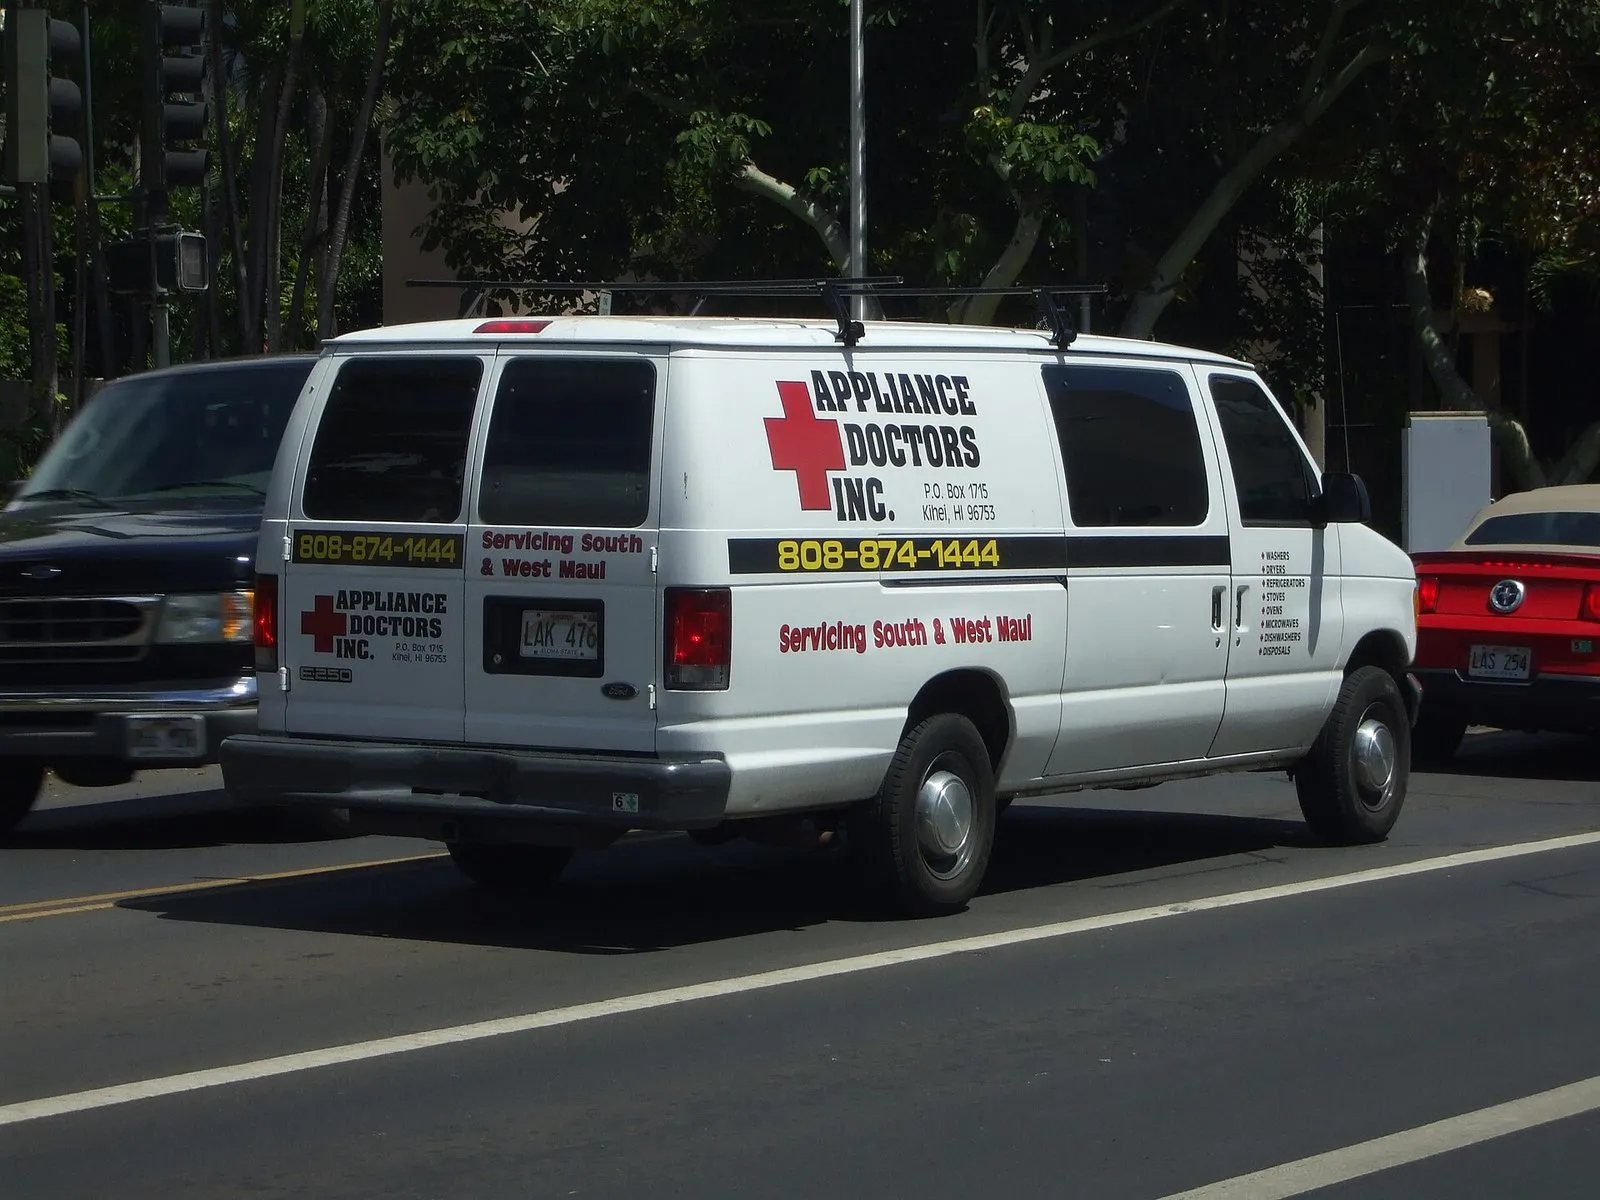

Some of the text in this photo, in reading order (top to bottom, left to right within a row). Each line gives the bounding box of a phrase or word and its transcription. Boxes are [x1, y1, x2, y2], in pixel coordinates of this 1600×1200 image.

[810, 370, 978, 416] APPLIANCE
[843, 423, 981, 468] DOCTORS
[832, 477, 896, 522] INC.
[923, 483, 989, 499] P.O. Box 1715
[922, 504, 996, 524] Kihei, HI 96753
[299, 534, 456, 564] 808-874-1444
[482, 530, 643, 554] Servicing South
[777, 539, 1000, 570] 808-874-1444
[1266, 551, 1290, 560] WASHERS
[480, 557, 494, 576] &
[502, 558, 551, 577] West
[1266, 565, 1286, 574] DRYERS
[1266, 578, 1306, 588] REFRIGERATORS
[336, 590, 447, 614] APPLIANCE
[1266, 592, 1286, 602] STOVES
[1266, 606, 1283, 615] OVENS
[350, 614, 442, 639] DOCTORS
[1265, 619, 1299, 629] MICROWAVES
[524, 621, 597, 649] LAK 476
[779, 621, 867, 654] Servicing
[874, 618, 928, 649] South
[933, 618, 946, 646] &
[949, 616, 993, 643] West
[1264, 632, 1301, 642] DISHWASHERS
[336, 638, 375, 661] INC.
[395, 642, 443, 653] P.O. Box 1715
[1262, 646, 1291, 656] DISPOSALS
[425, 654, 447, 664] 96753
[1472, 651, 1528, 672] LAS 254
